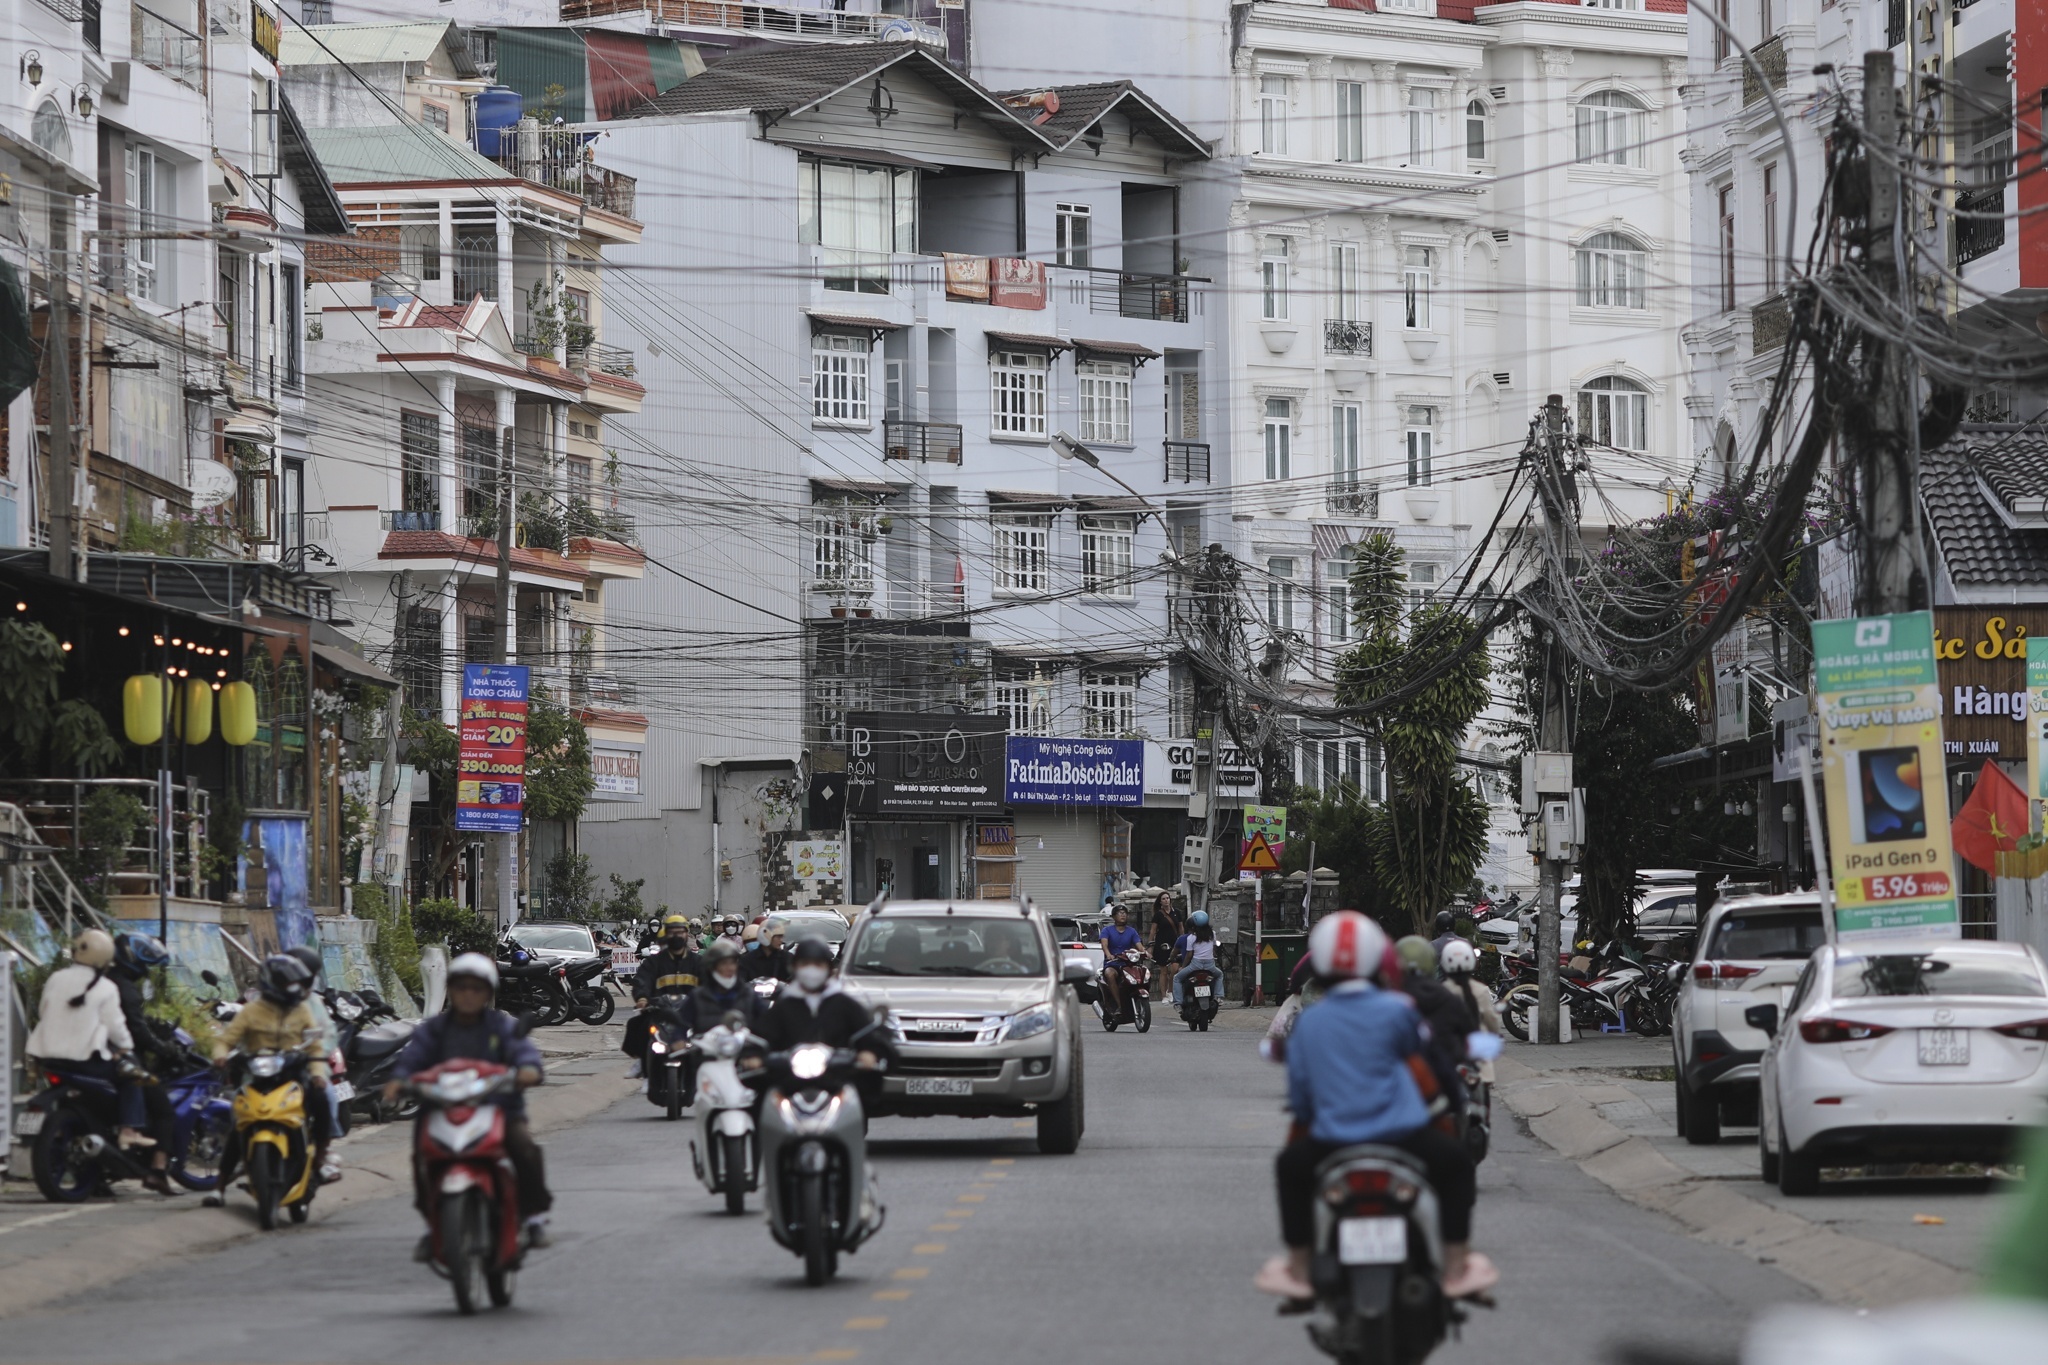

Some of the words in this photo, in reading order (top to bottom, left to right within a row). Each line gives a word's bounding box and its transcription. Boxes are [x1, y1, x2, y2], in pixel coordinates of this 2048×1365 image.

[1820, 653, 1860, 668] HOÀNG
[1863, 650, 1879, 665] HÀ
[1883, 648, 1929, 663] MOBILE
[473, 677, 489, 686] NHÀ
[491, 677, 517, 687] THUỐC
[468, 688, 495, 697] LONG
[496, 688, 522, 698] CHÂU
[1954, 685, 2027, 721] Hàng
[462, 732, 486, 741] GIẢM
[486, 725, 525, 744] 20%
[1039, 743, 1050, 755] Mỹ
[1052, 744, 1072, 756] Nghệ
[1073, 744, 1094, 757] Công
[1095, 745, 1113, 756] Giáo
[1944, 741, 1963, 756] THỊ
[1968, 738, 1999, 753] XUÂN
[460, 759, 523, 774] 390.000đ
[593, 755, 614, 775] MINH
[847, 759, 875, 775] BÔN
[927, 766, 950, 780] HAIR
[952, 766, 984, 780] SALON
[1009, 759, 1141, 786] FatimaBoscoĐalat
[929, 785, 940, 794] HỌC
[951, 784, 971, 793] CHUYÊN
[1027, 792, 1036, 800] Bùi
[1036, 792, 1044, 801] Thị
[1044, 792, 1058, 801] Xuân
[1083, 794, 1091, 802] Lạt
[1845, 852, 1883, 870] iPad
[1888, 851, 1922, 867] Gen
[1926, 848, 1937, 863] 9
[1871, 875, 1918, 899] 5.96
[1921, 881, 1948, 895] Triệu
[919, 1021, 964, 1031] ISUZU
